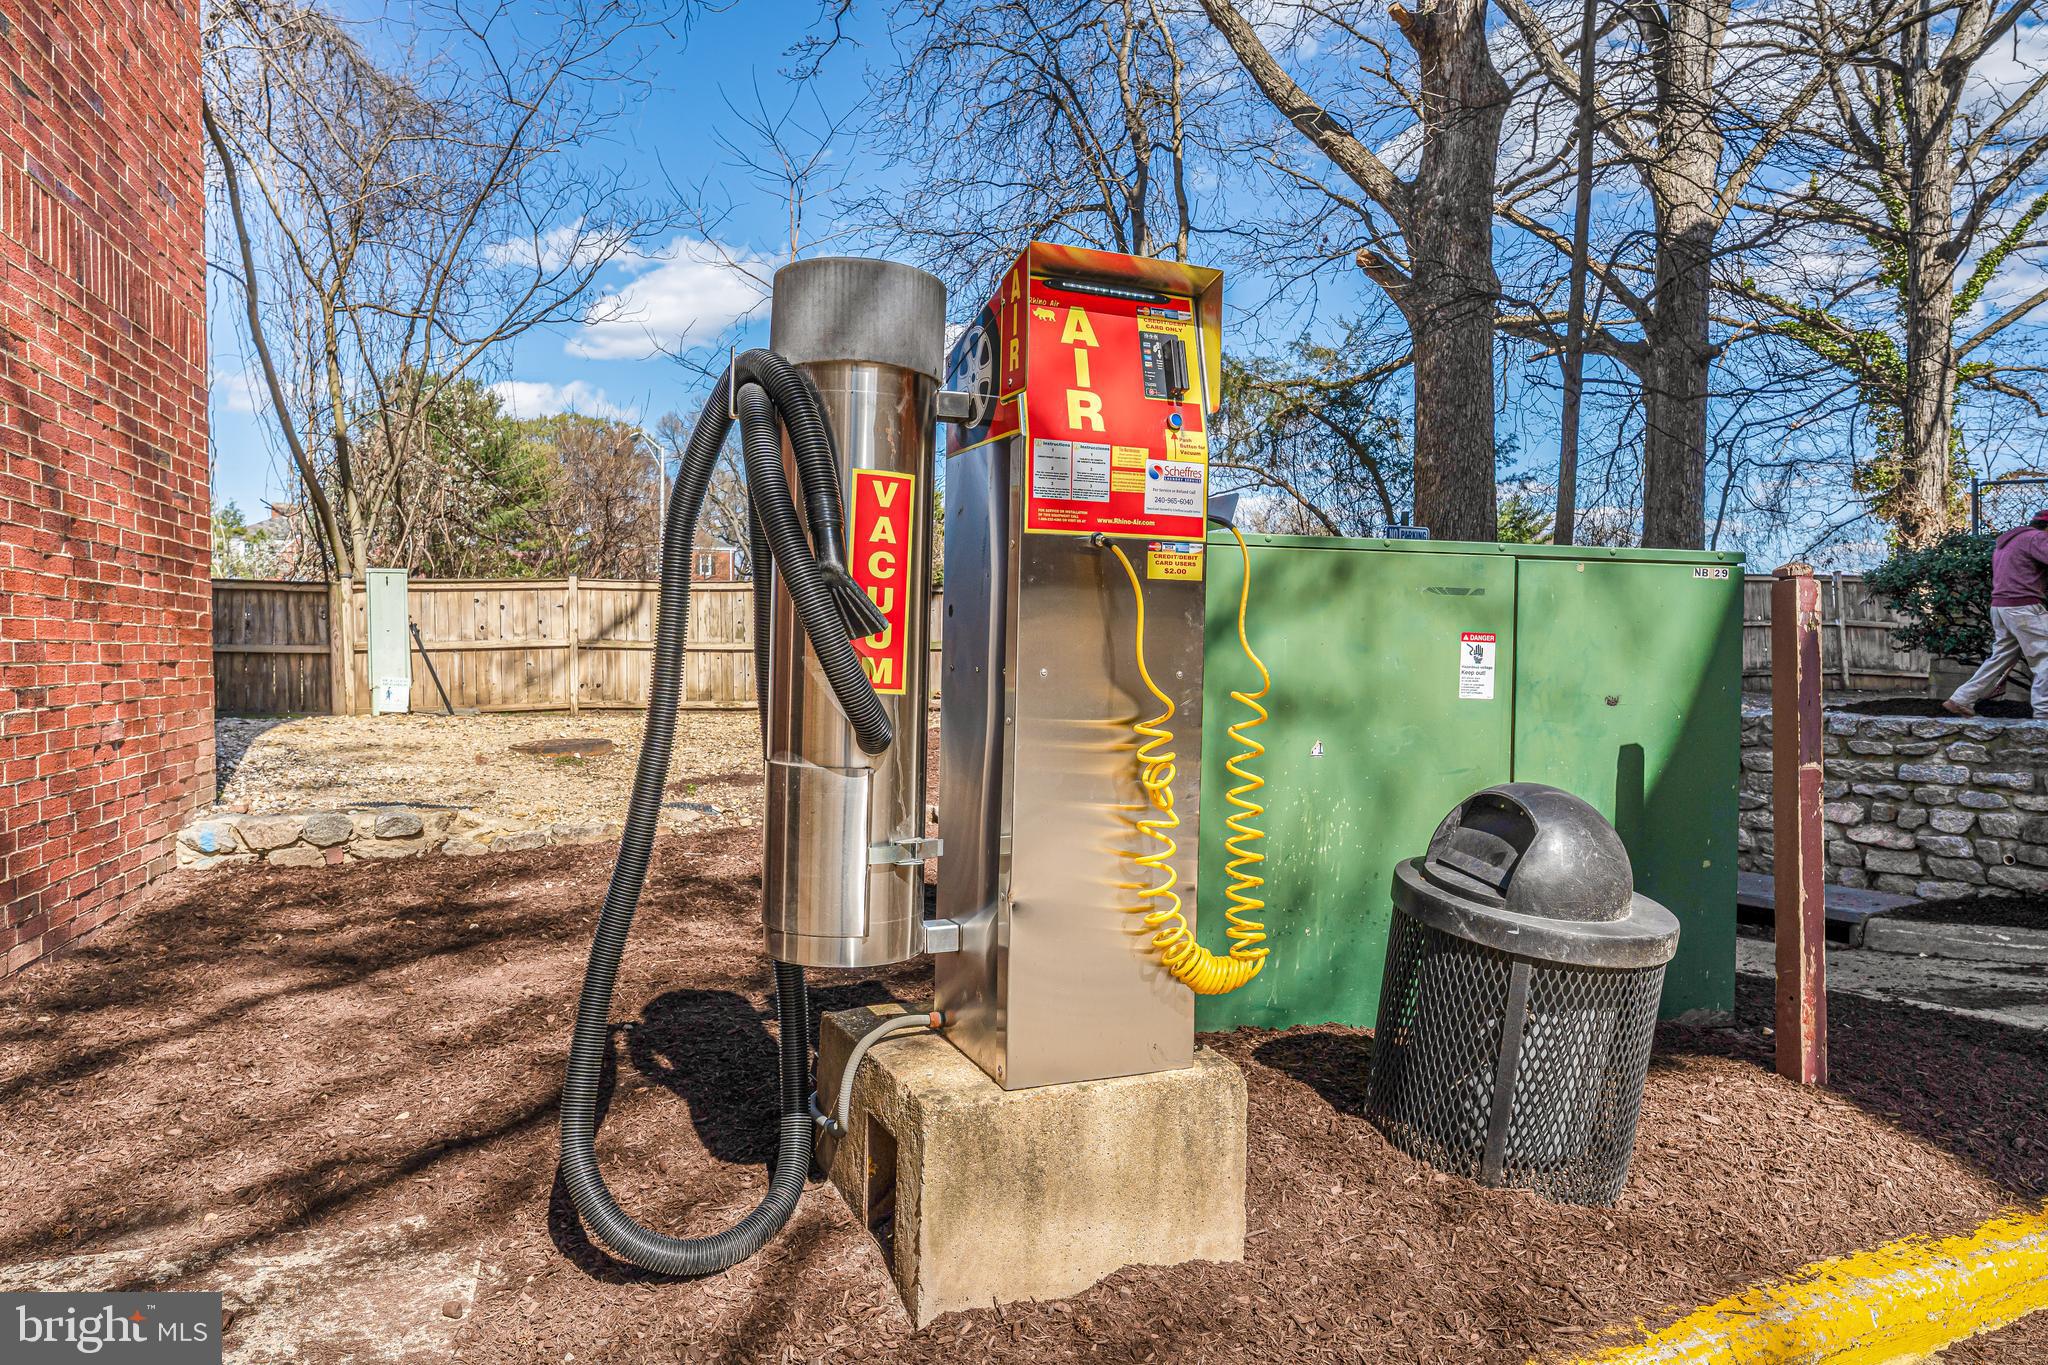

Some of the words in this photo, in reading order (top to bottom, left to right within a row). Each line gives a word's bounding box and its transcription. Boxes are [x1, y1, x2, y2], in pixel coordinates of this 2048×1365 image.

[1050, 299, 1060, 307] Air
[1009, 268, 1021, 372] AIR
[1143, 317, 1188, 328] CREDIT/DEBIT
[1060, 305, 1106, 432] AIR
[1164, 465, 1202, 478] Scheffres
[1154, 497, 1193, 505] 240-965-6040
[1096, 517, 1156, 527] www.Rhino-Air.com
[1401, 530, 1428, 539] PARKING
[1153, 553, 1199, 561] CREDIT/DEBIT
[1164, 567, 1187, 575] $2.00
[1694, 568, 1709, 577] NB
[1714, 569, 1728, 578] 29
[861, 479, 899, 684] VACUUM
